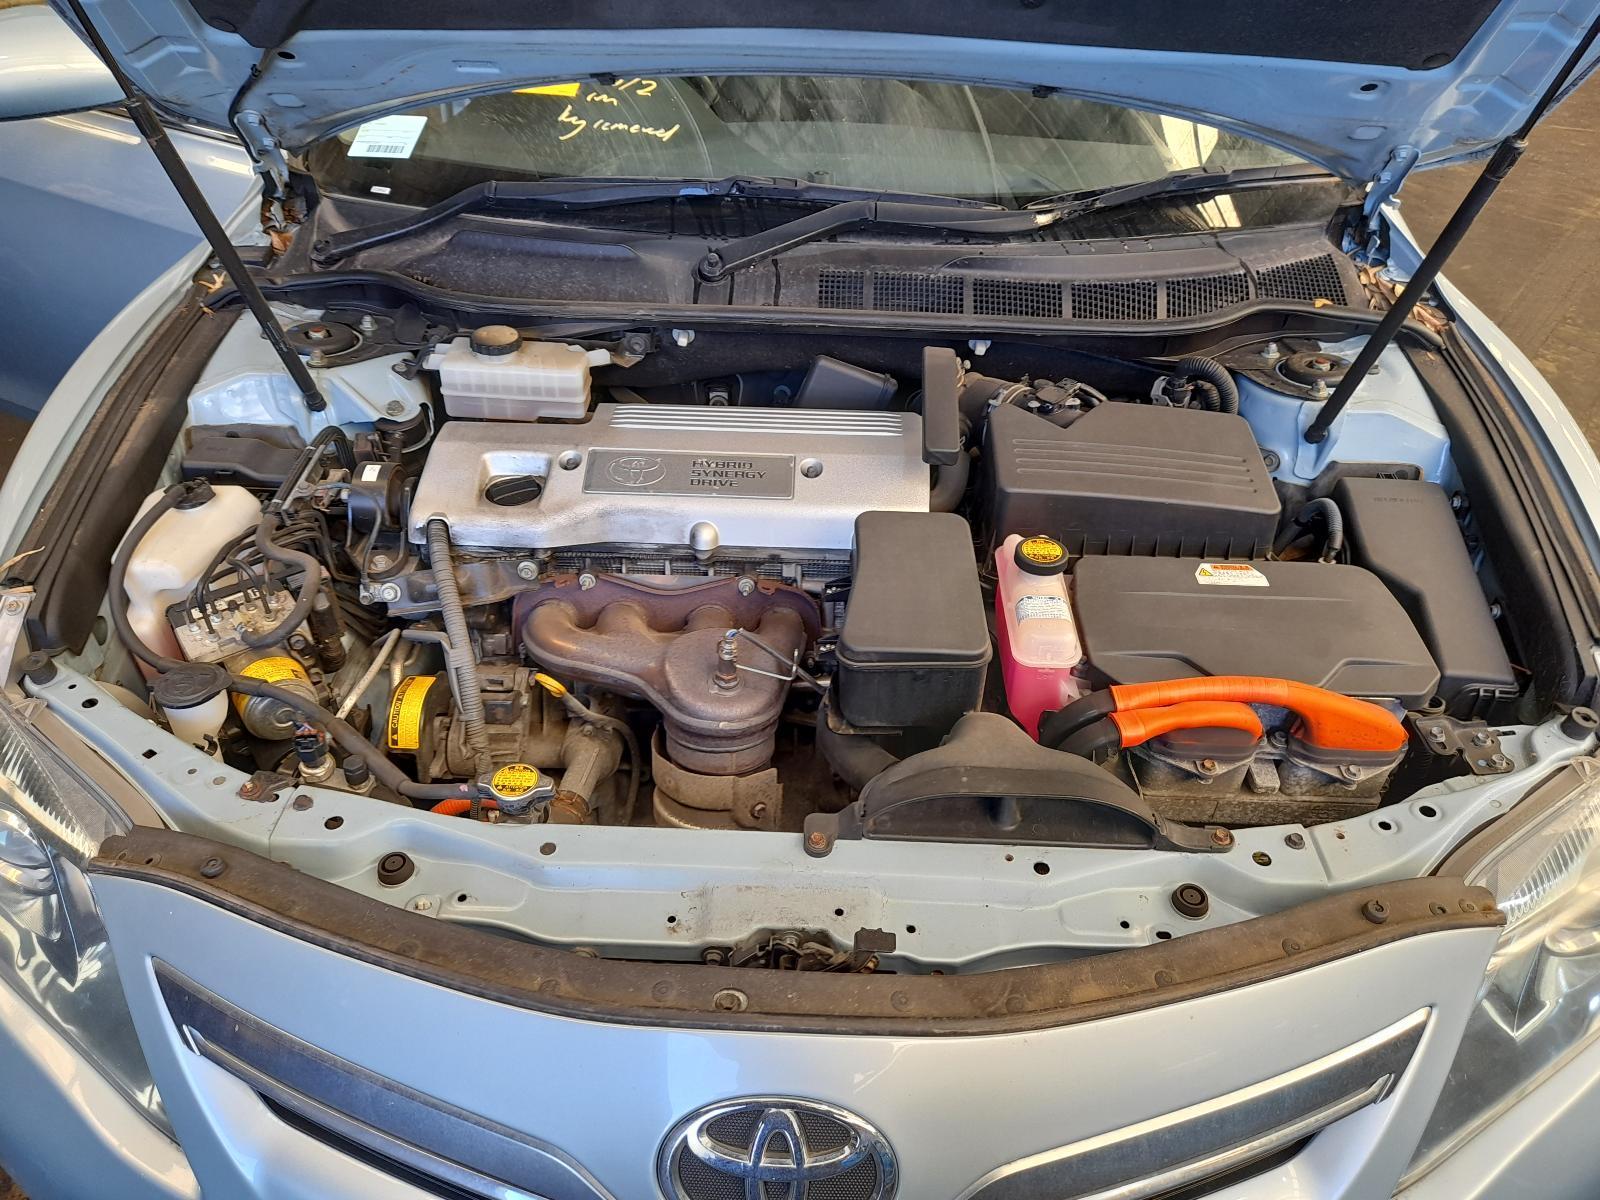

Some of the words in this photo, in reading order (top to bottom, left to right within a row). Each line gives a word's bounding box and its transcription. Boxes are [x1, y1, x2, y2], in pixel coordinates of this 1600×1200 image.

[692, 460, 753, 469] HYBRID
[690, 469, 766, 479] SYNERGY
[690, 479, 739, 487] DRIVE
[391, 699, 402, 729] CAUTION
